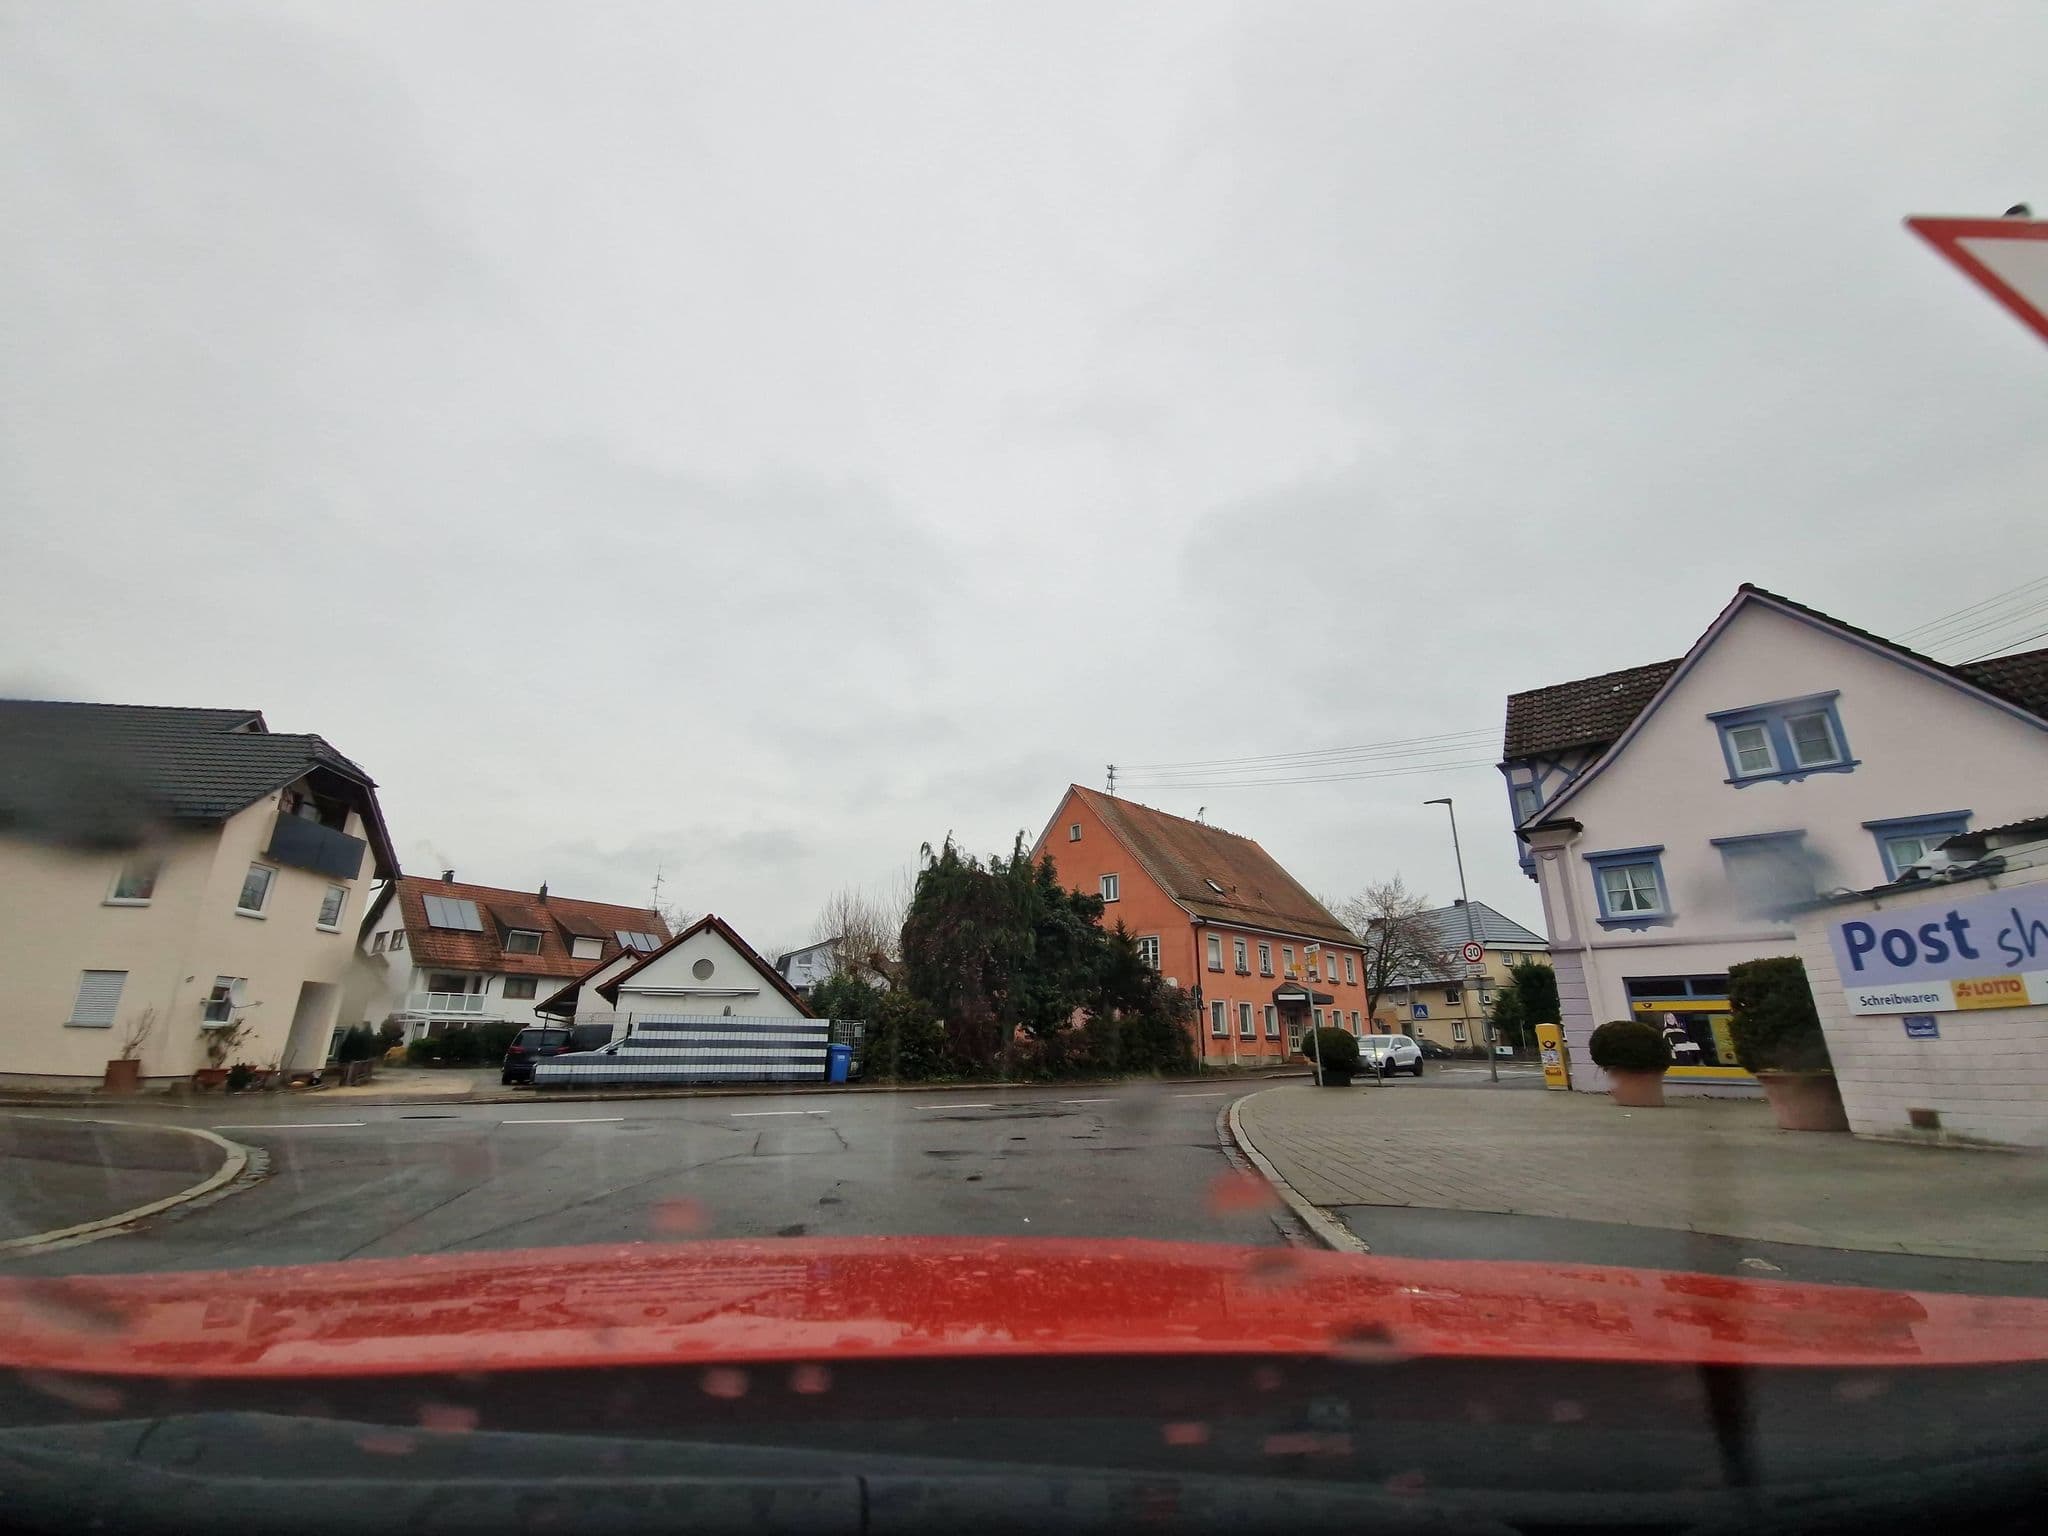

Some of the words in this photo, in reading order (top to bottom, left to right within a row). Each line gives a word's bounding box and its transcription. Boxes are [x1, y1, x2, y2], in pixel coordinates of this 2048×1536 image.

[1841, 909, 1980, 972] Post
[1467, 947, 1479, 958] 30
[1973, 979, 2022, 996] LOTTO
[1860, 992, 1939, 1007] Schreibwaren
